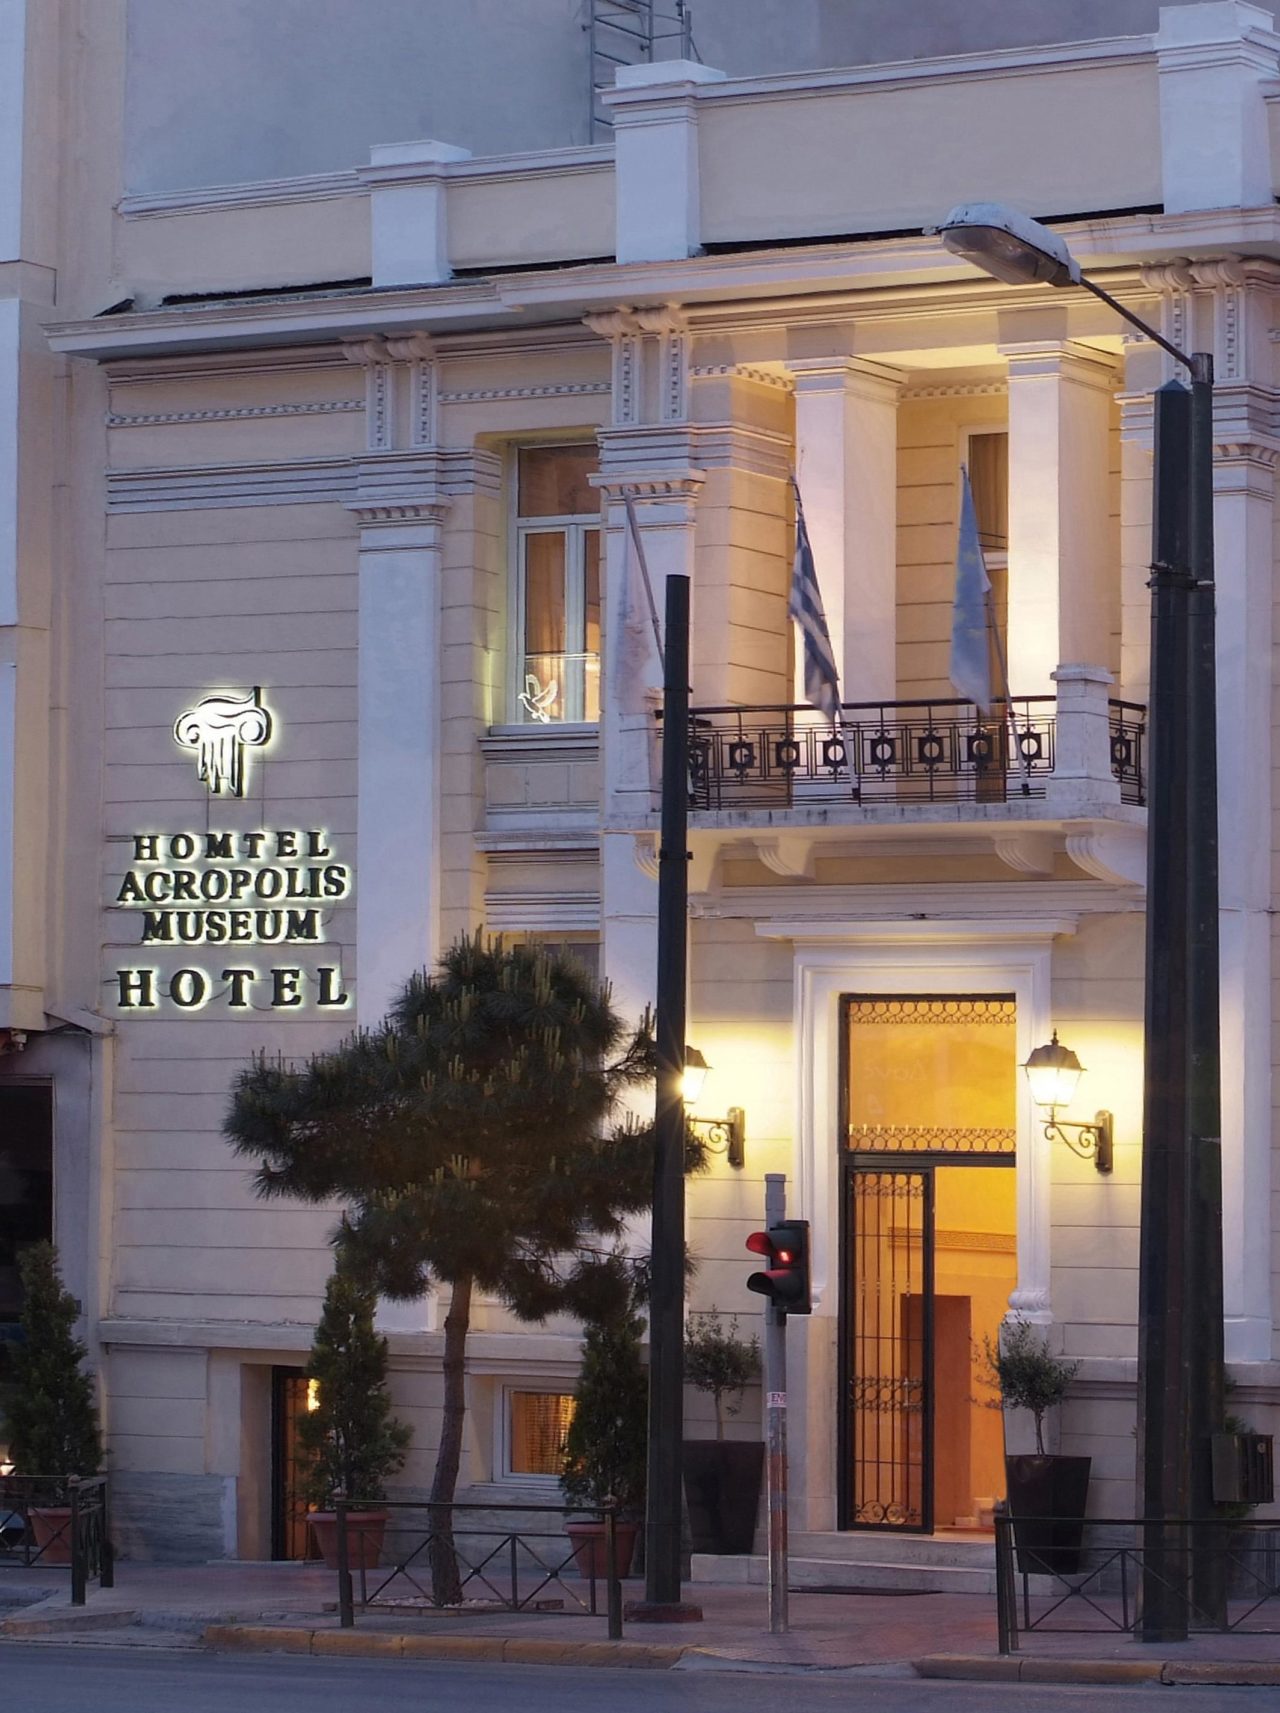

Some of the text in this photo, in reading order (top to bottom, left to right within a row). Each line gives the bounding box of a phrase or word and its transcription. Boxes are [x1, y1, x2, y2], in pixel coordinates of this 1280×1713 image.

[133, 832, 330, 861] HOMTEL
[117, 866, 347, 901] ACROPOLIS
[141, 910, 320, 941] MUSEUM
[116, 968, 348, 1007] HOTEL
